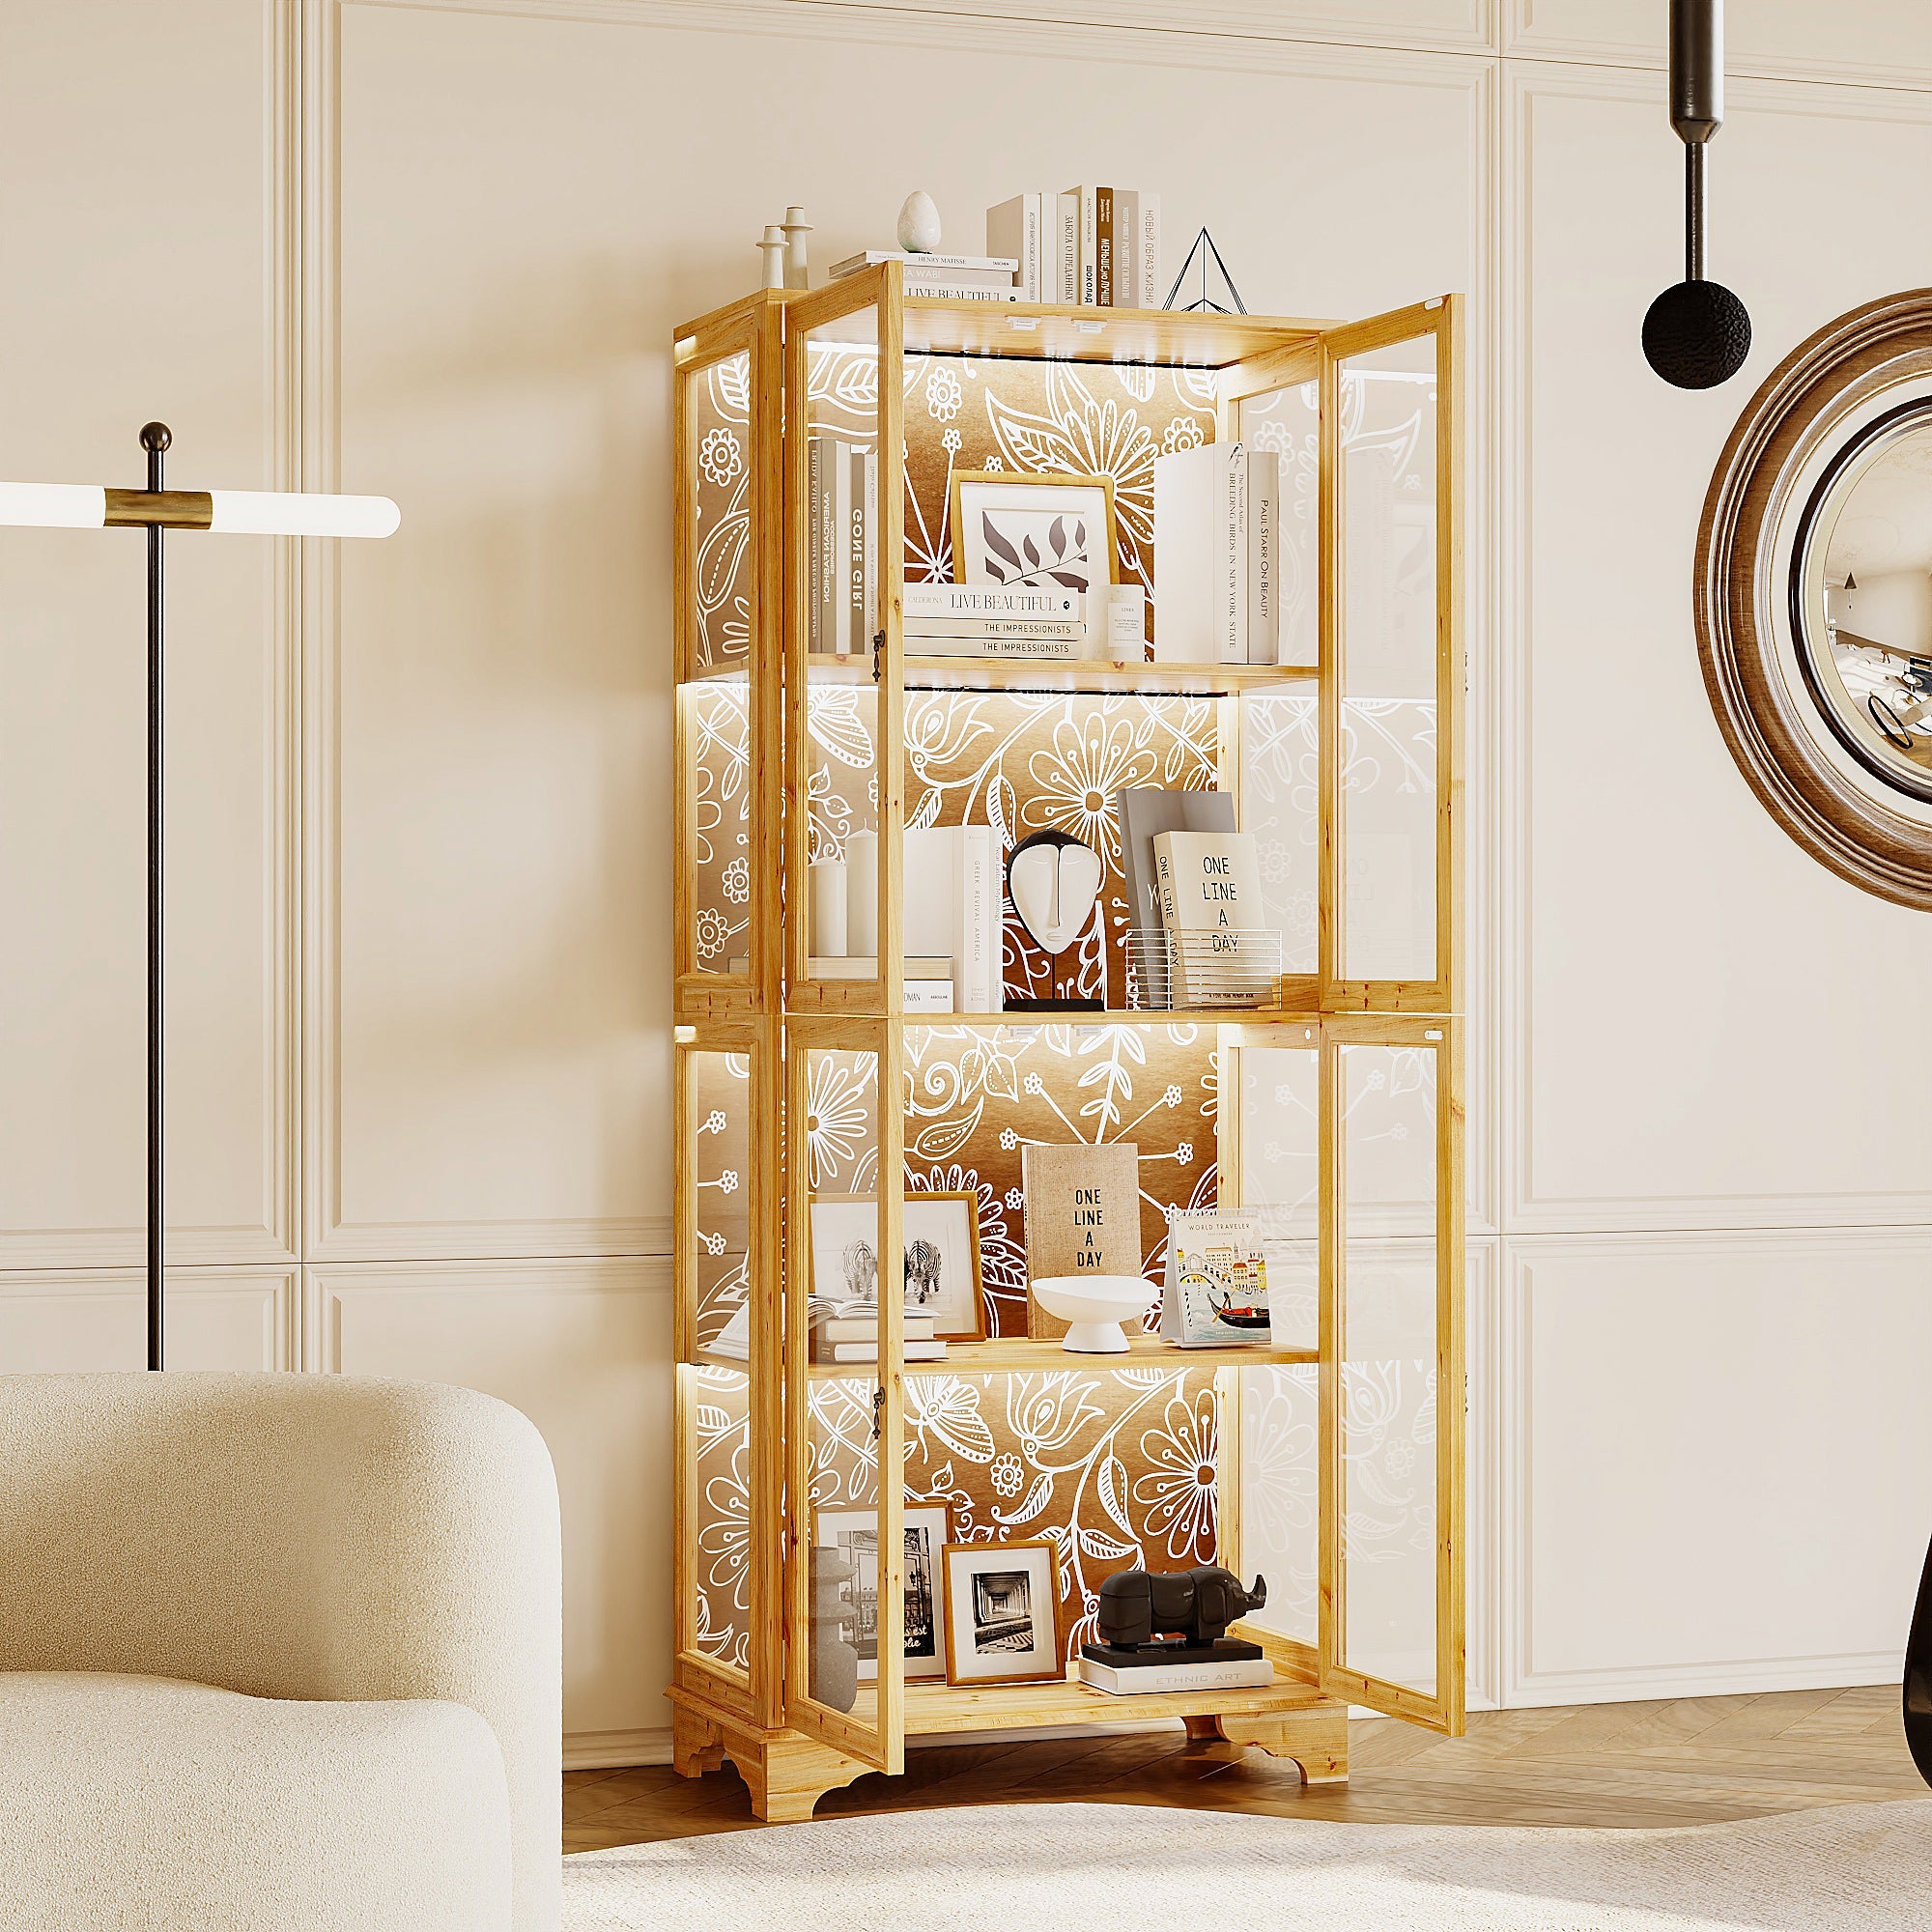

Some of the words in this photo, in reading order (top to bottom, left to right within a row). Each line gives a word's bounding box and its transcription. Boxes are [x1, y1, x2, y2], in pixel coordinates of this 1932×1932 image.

[1065, 214, 1073, 243] ЗАБОТА
[1145, 210, 1156, 241] НОВЫЙ
[1145, 243, 1154, 270] ОБРАЗ
[1064, 253, 1073, 301] ПРЕДАННЫХ
[1084, 265, 1094, 303] ШОКОЛАД
[1100, 280, 1110, 306] ЛУЧШЕ
[1144, 272, 1154, 303] ЖИЗНИ
[1229, 554, 1236, 565] IN
[950, 593, 981, 610] LIVE
[983, 595, 1057, 611] BEAUTIFUL
[984, 623, 1000, 633] THE
[1003, 624, 1071, 635] IMPRESSIONISTS
[982, 642, 999, 651] THE
[1001, 643, 1069, 653] IMPRESSIONISTS
[1159, 856, 1170, 880] ONE
[1202, 856, 1231, 875] ONE
[1202, 882, 1237, 901] LINE
[1163, 888, 1175, 920] LINE
[1218, 908, 1229, 926] A
[1211, 934, 1238, 952] DAY
[1075, 1188, 1101, 1206] ONE
[1074, 1209, 1104, 1226] LINE
[1216, 1222, 1251, 1231] TRAVELER
[1085, 1231, 1094, 1247] A
[1077, 1251, 1102, 1267] DAY
[1156, 1674, 1208, 1685] ETHNIC
[1215, 1672, 1242, 1681] ART
